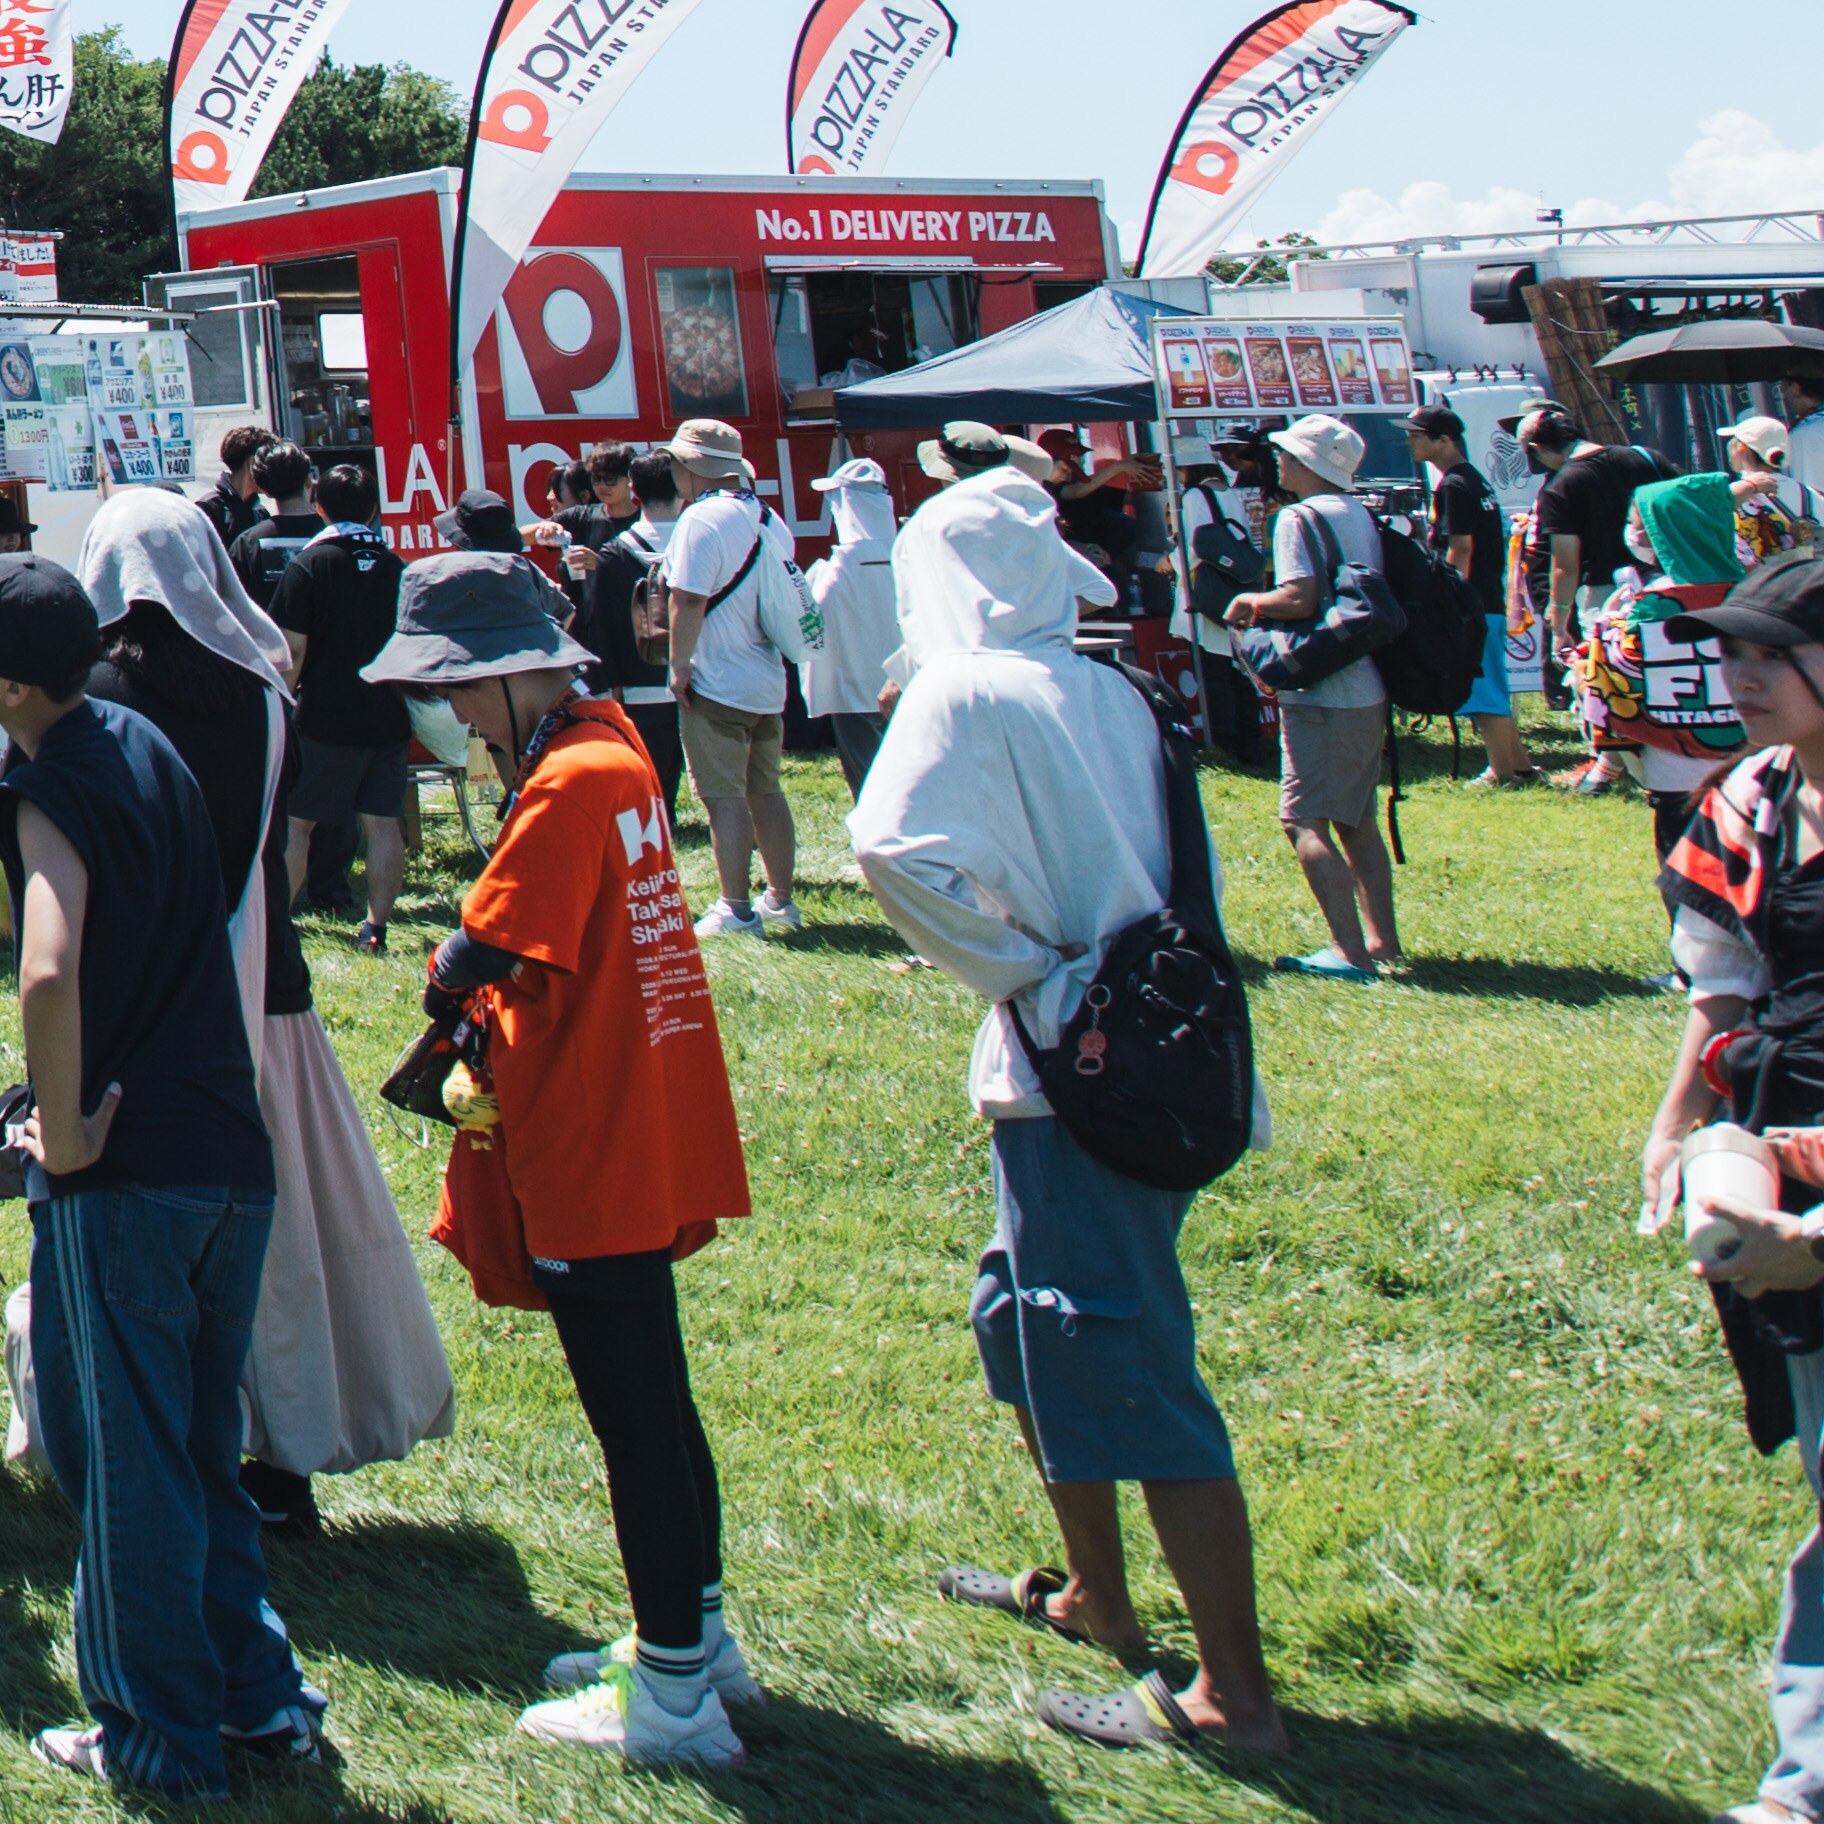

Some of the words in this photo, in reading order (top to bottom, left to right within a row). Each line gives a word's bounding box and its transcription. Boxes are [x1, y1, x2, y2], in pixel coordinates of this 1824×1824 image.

[568, 23, 629, 105] JAPAN
[846, 113, 884, 172] JAPAN
[875, 25, 941, 112] STANDARD
[239, 76, 279, 138] JAPAN
[756, 210, 824, 241] No.1
[830, 210, 963, 242] DELIVERY
[968, 211, 1057, 242] PIZZA
